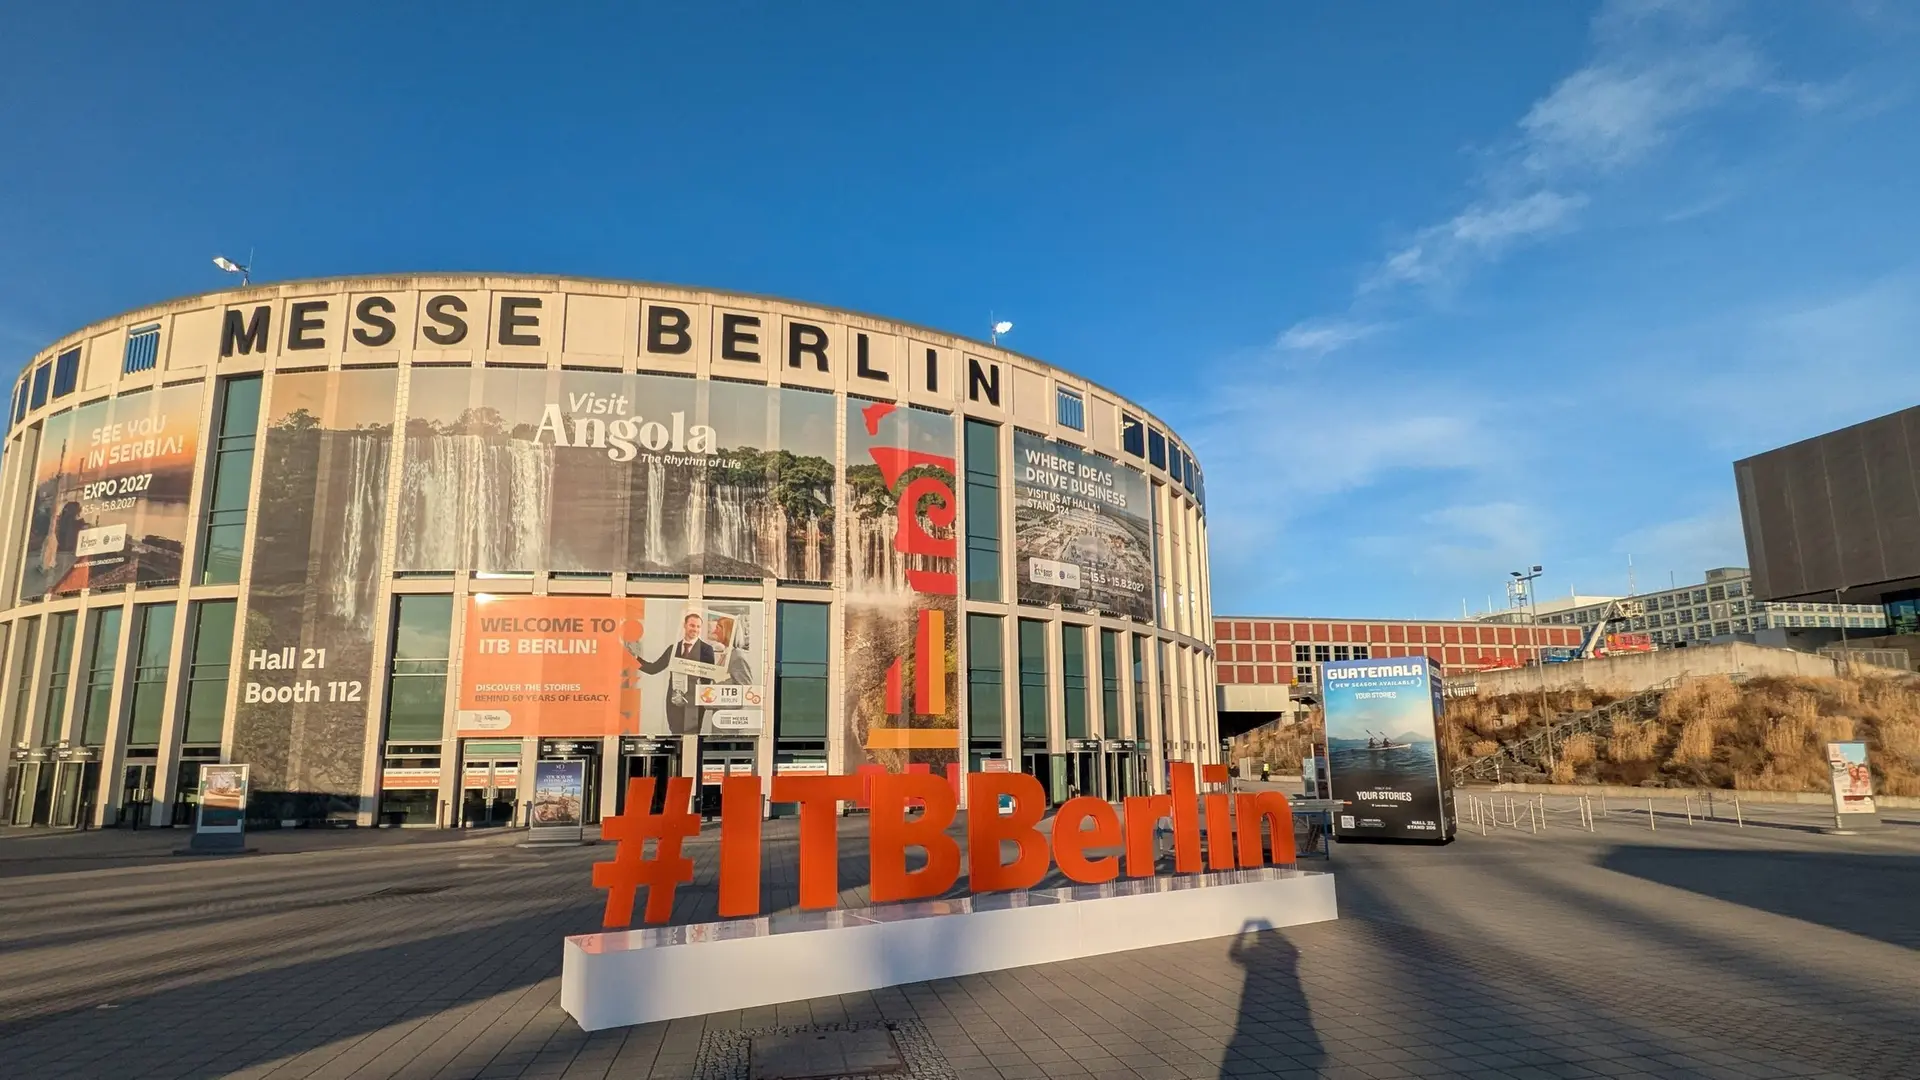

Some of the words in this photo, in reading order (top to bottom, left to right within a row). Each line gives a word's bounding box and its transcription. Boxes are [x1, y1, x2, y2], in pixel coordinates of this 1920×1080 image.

[221, 295, 543, 357] MESSE
[647, 305, 1000, 407] BERLIN
[568, 391, 628, 416] Visit
[91, 423, 122, 447] SEE
[127, 414, 166, 439] YOU
[533, 403, 718, 462] Angola
[88, 448, 105, 469] IN
[109, 434, 184, 465] SERBIA!
[641, 453, 661, 464] The
[663, 454, 706, 467] Rhythm
[708, 458, 721, 467] of
[722, 458, 741, 469] Life
[1025, 448, 1075, 475] WHERE
[1078, 463, 1112, 487] IDEAS
[83, 479, 117, 500] EXPO
[119, 473, 153, 494] 2027
[1025, 466, 1068, 490] DRIVE
[1071, 478, 1126, 507] BUSINESS
[101, 496, 137, 512] 15.8.2027
[1026, 486, 1049, 501] VISIT
[1049, 491, 1061, 504] US
[1061, 495, 1072, 506] AT
[1072, 497, 1093, 512] HALL
[1027, 498, 1056, 513] STAND
[1056, 504, 1070, 515] 124
[480, 617, 584, 633] WELCOME
[590, 617, 616, 633] TO
[248, 646, 297, 670] Hall
[301, 648, 326, 669] 21
[479, 638, 511, 654] ITB
[517, 638, 598, 654] BERLIN!
[1327, 664, 1422, 680] GUATEMALA
[244, 679, 320, 703] Booth
[328, 680, 362, 702] 112
[475, 683, 521, 692] DISCOVER
[524, 683, 541, 691] THE
[543, 683, 581, 692] STORIES
[475, 694, 510, 702] BEHIND
[512, 694, 524, 702] 60
[525, 694, 556, 702] YEARS
[558, 694, 571, 702] OF
[573, 694, 611, 702] LEGACY.
[721, 688, 738, 696] ITB
[1372, 691, 1397, 699] STORIES
[1356, 791, 1378, 801] YOUR
[1379, 791, 1412, 802] STORIES
[592, 762, 1296, 929] #ITBBerlin
